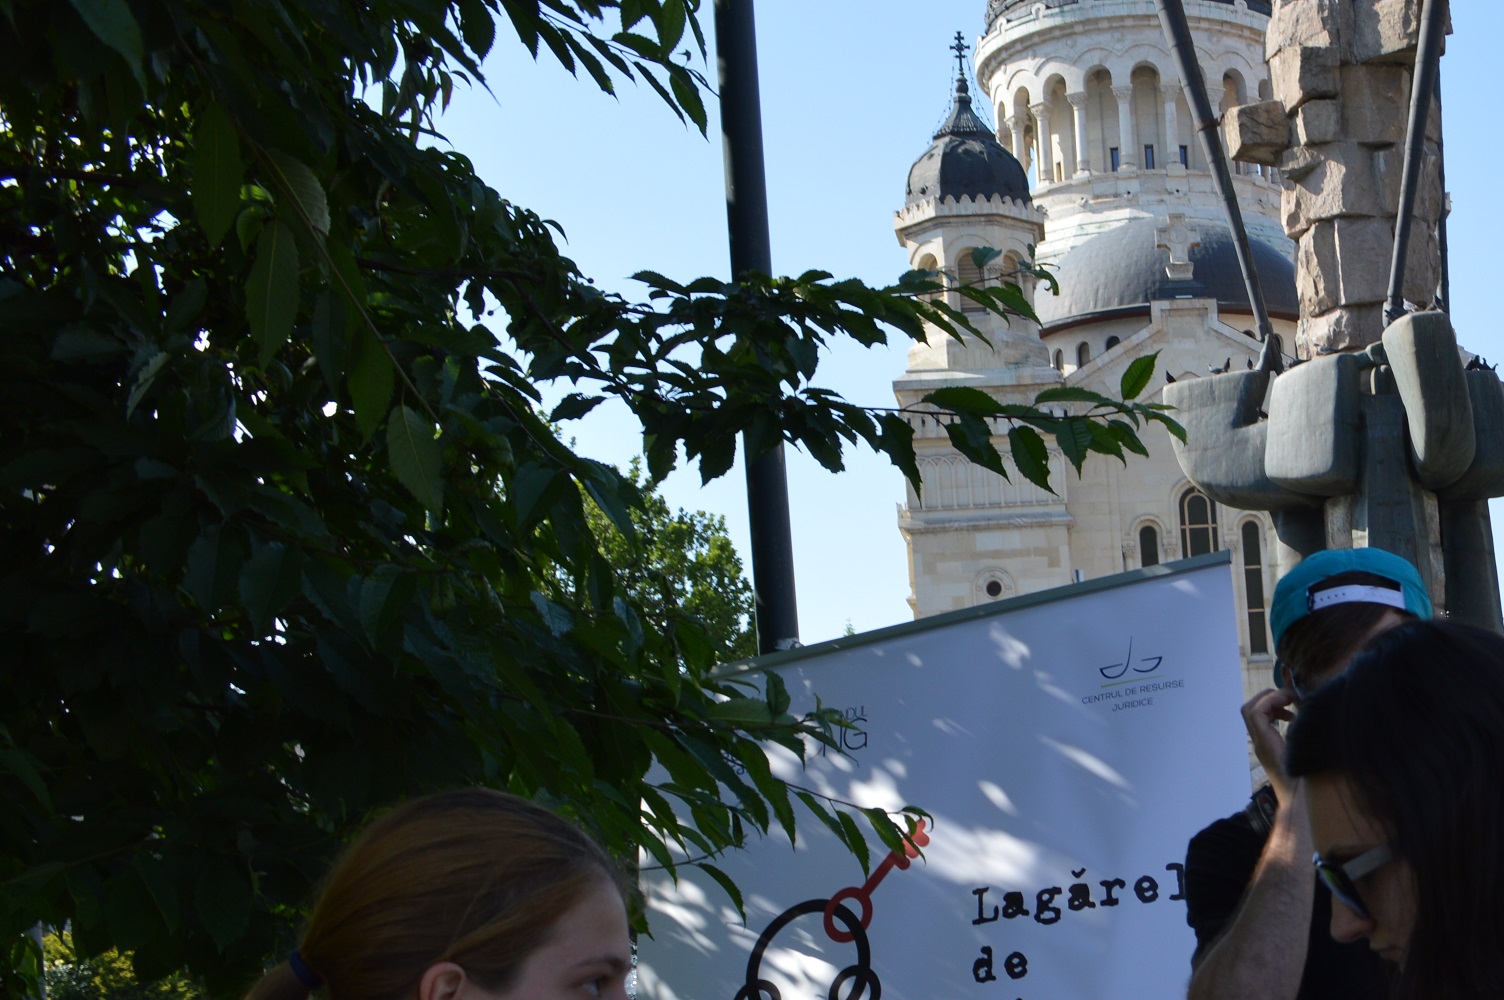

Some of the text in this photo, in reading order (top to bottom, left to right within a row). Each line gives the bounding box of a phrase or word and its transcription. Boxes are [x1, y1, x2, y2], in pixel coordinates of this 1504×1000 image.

[1081, 679, 1186, 705] CENTRUL DE RESURSE
[1112, 697, 1154, 712] JURIDICE
[973, 945, 1029, 984] de
